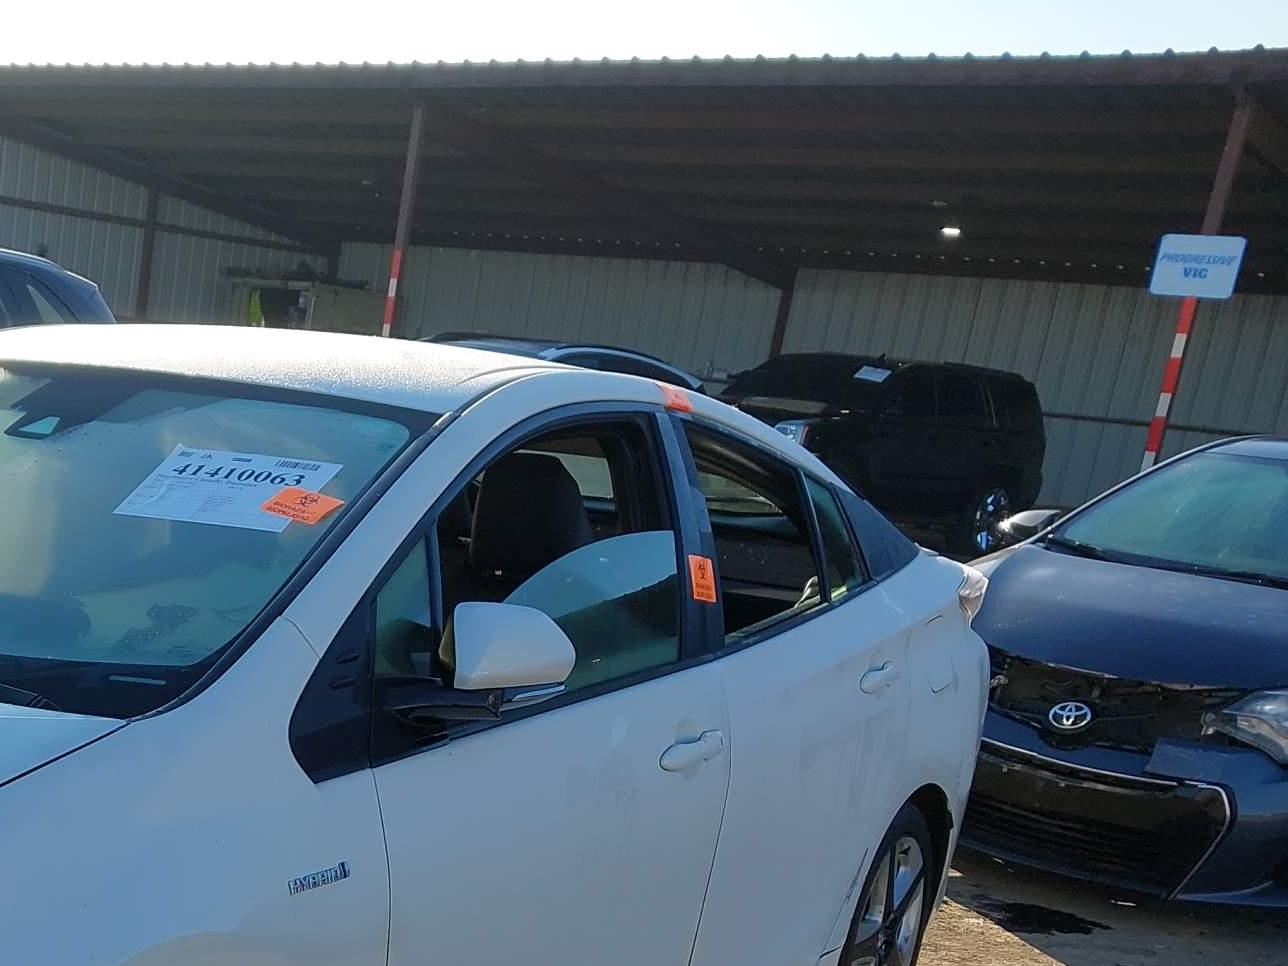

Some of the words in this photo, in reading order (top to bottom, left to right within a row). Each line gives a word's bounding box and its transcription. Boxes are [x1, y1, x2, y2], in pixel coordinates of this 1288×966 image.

[1160, 253, 1237, 266] PROGRESSIVE
[1183, 267, 1209, 279] VIC
[172, 463, 306, 487] 41410063
